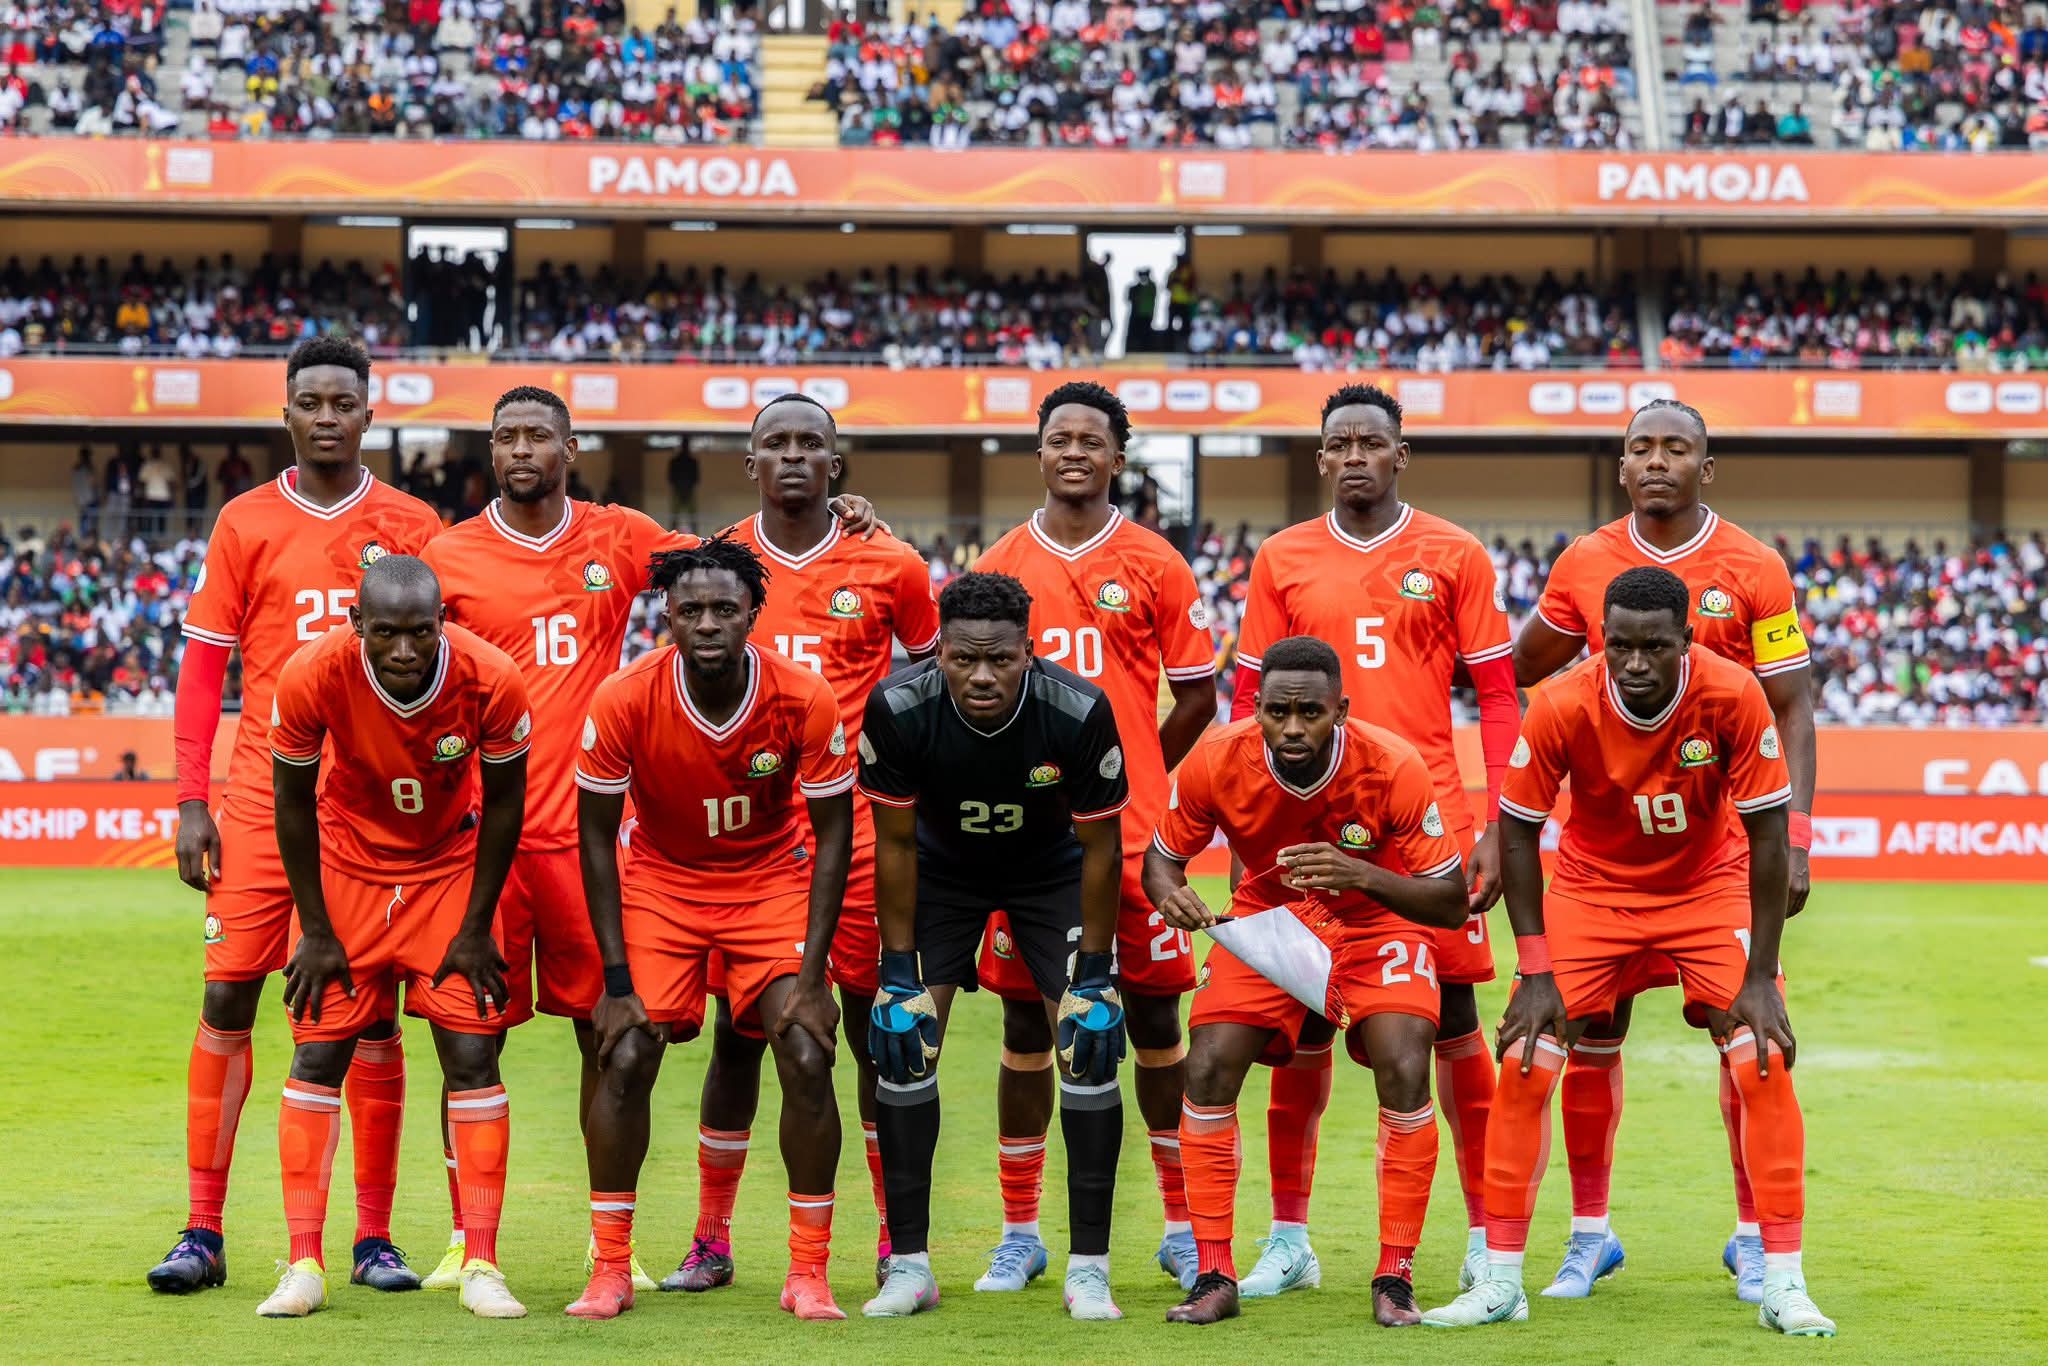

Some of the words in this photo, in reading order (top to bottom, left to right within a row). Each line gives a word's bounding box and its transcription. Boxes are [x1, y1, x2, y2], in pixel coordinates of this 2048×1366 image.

[588, 156, 798, 197] PAMOJA
[1598, 162, 1809, 202] PAMOJA
[294, 588, 358, 640] 25
[531, 613, 578, 666] 16
[1042, 627, 1104, 678] 20
[1355, 616, 1386, 669] 5
[391, 777, 424, 815] 8
[1923, 758, 2048, 796] CA
[702, 795, 751, 838] 10
[959, 800, 1024, 834] 23
[1632, 792, 1689, 835] 19
[1885, 820, 2048, 857] AFRICAN
[1376, 940, 1437, 992] 24
